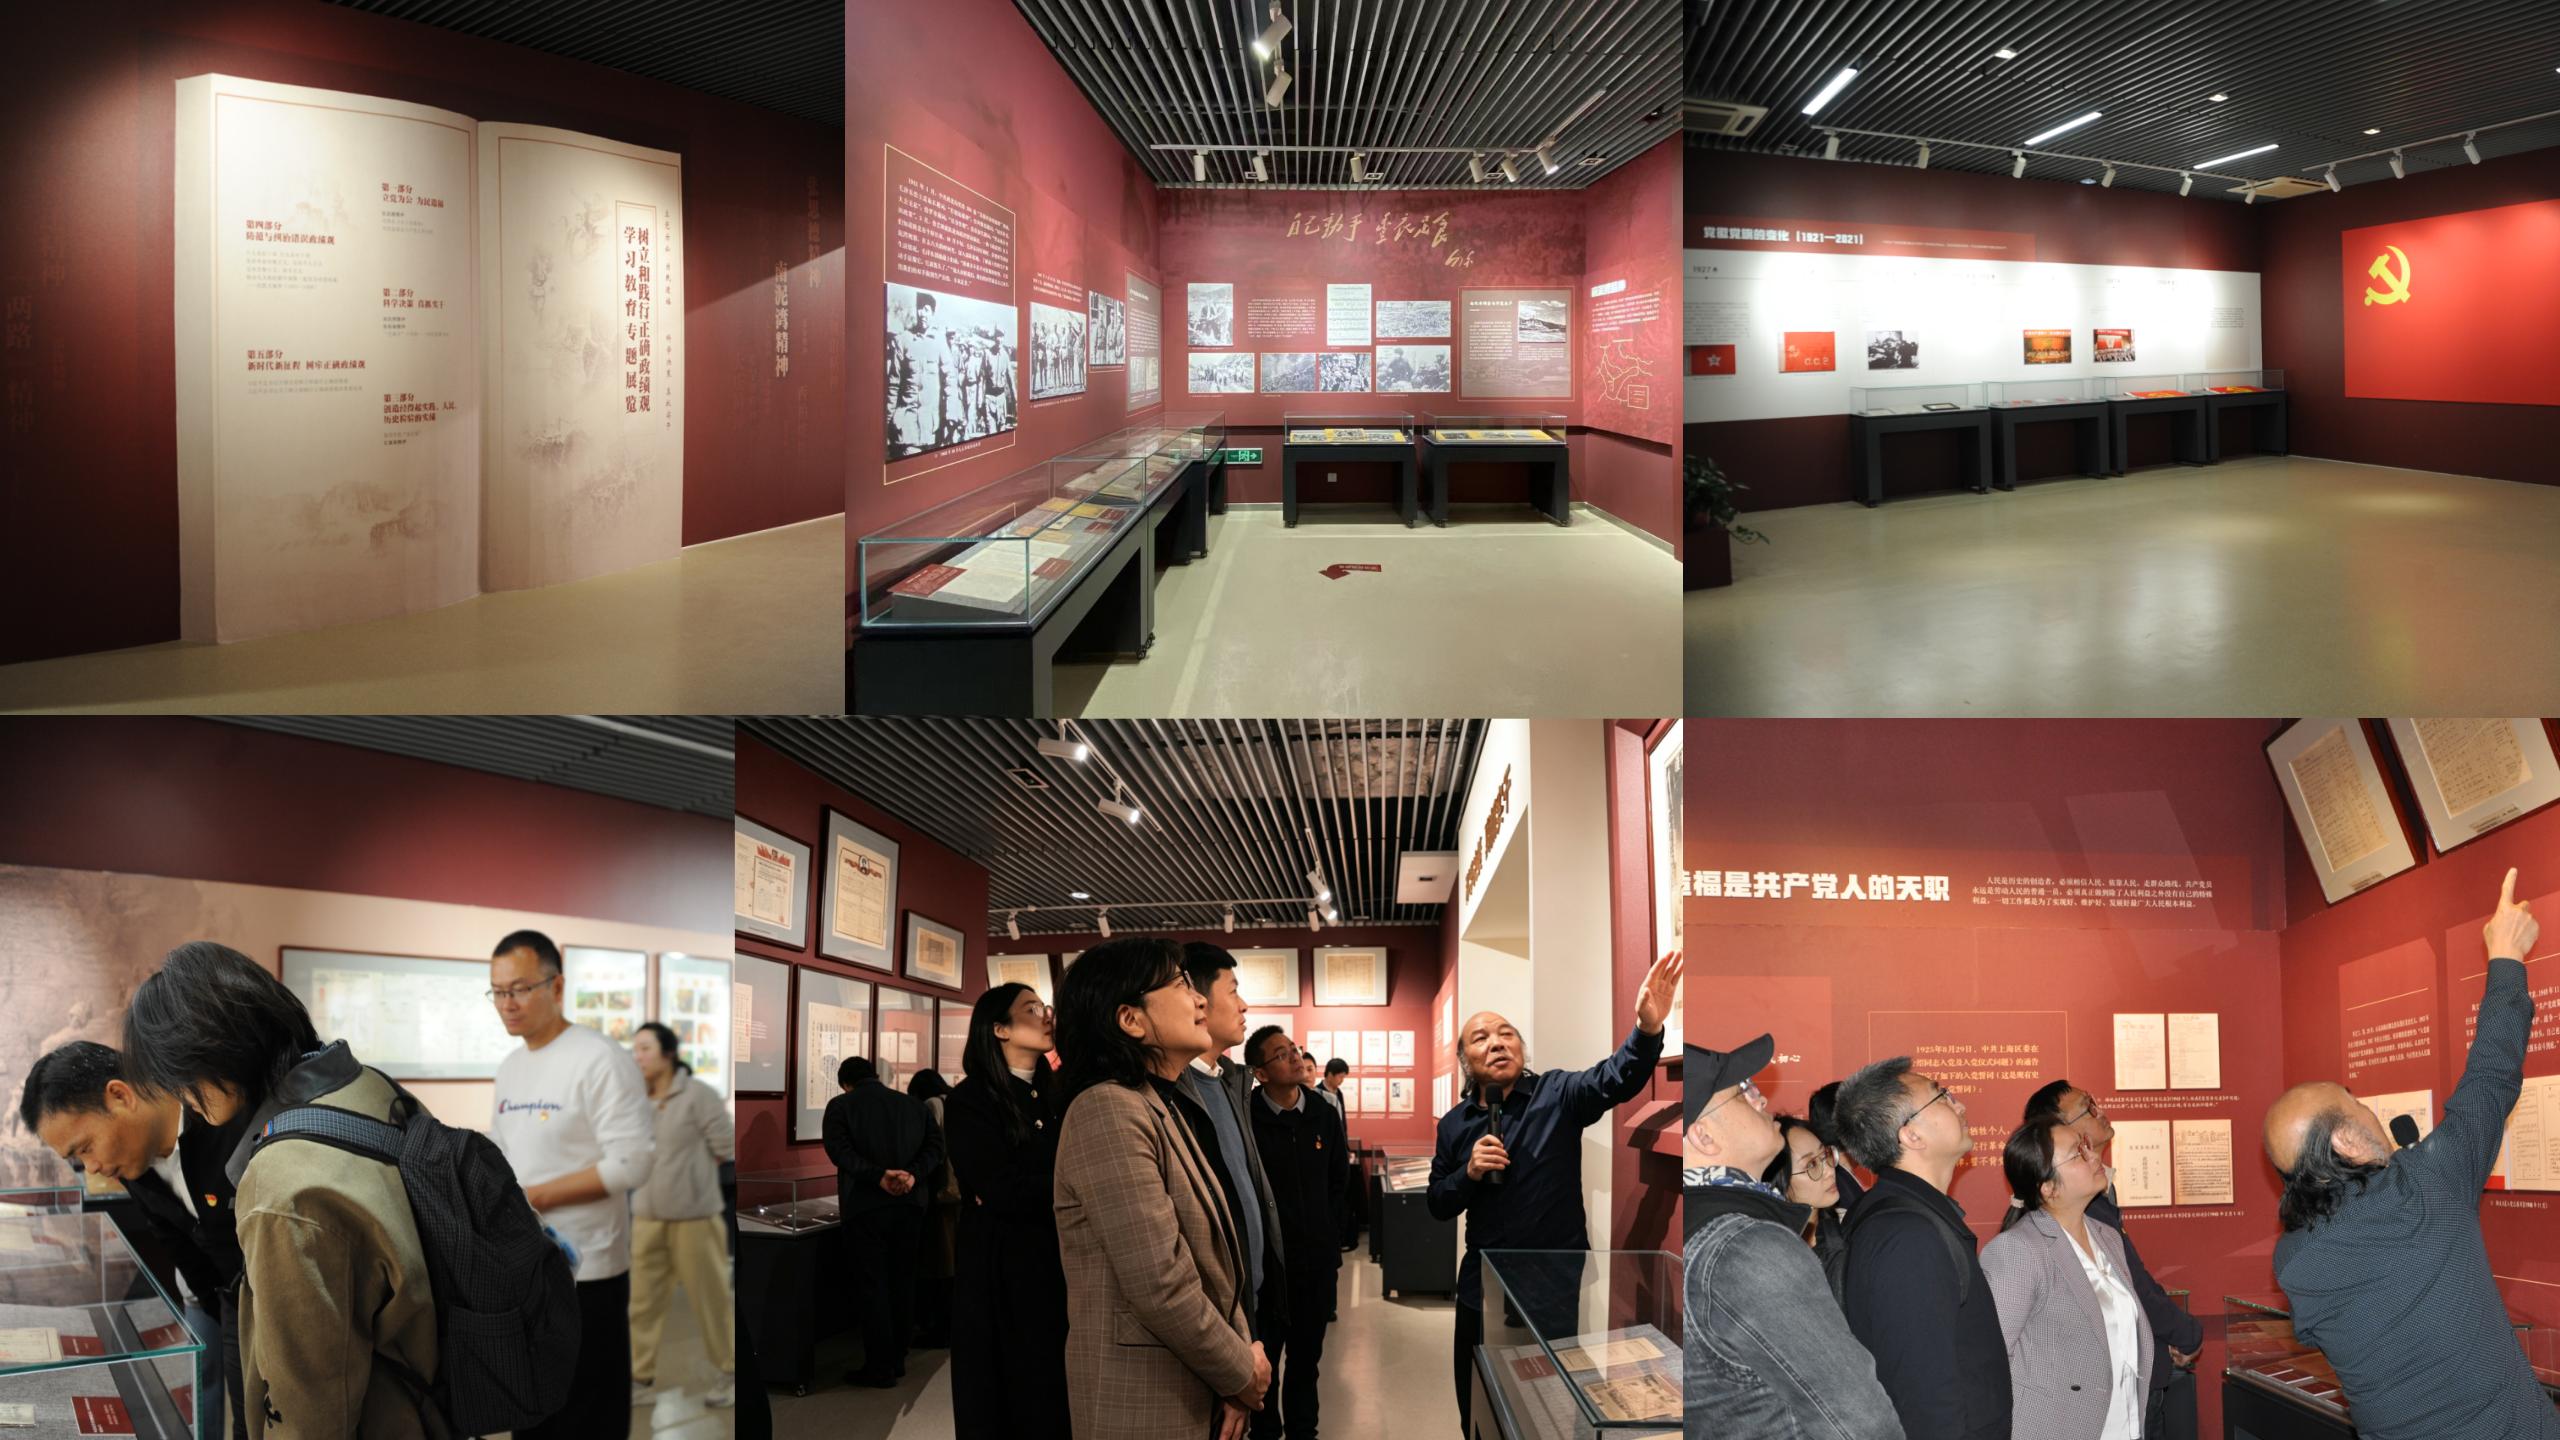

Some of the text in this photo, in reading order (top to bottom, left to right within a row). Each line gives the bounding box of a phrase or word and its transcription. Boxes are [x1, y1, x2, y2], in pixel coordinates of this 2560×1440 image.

[1703, 226, 1790, 242] 党徽党旗的变化
[624, 226, 638, 414] 学习教育专题展览
[637, 227, 651, 413] 树立和践行正确政绩观
[774, 260, 789, 378] 南泥湾精神
[1770, 1053, 1801, 1064] 初心
[498, 1098, 563, 1116] Champion
